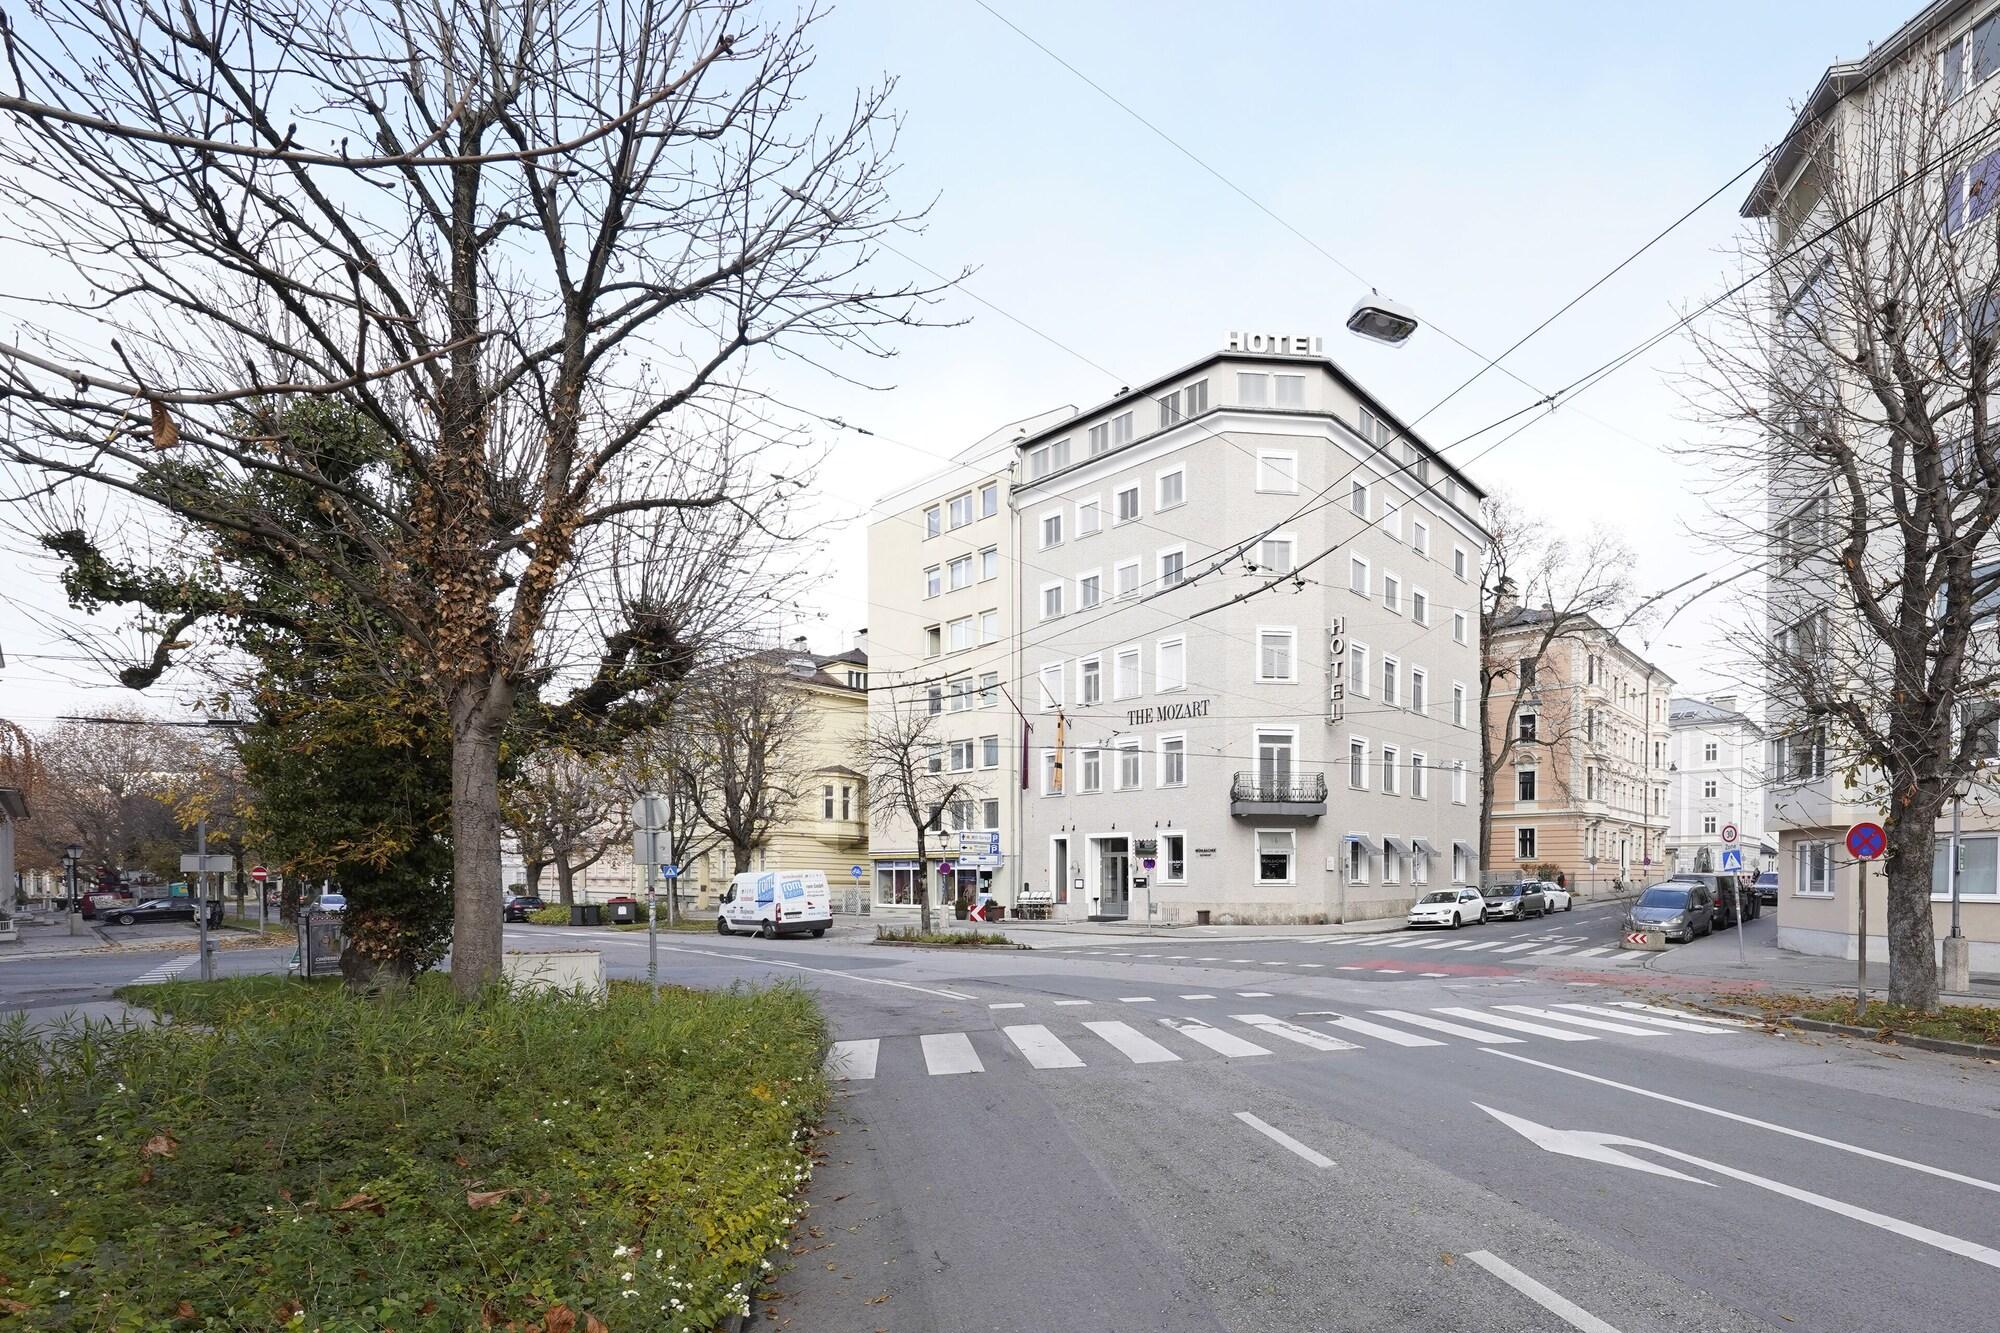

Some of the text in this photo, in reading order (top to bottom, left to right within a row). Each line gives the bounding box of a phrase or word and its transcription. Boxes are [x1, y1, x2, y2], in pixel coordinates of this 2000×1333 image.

[1225, 330, 1322, 355] HOTEL
[1330, 616, 1344, 721] HOTEL
[1127, 699, 1210, 726] THE MOZART
[782, 881, 803, 892] rom
